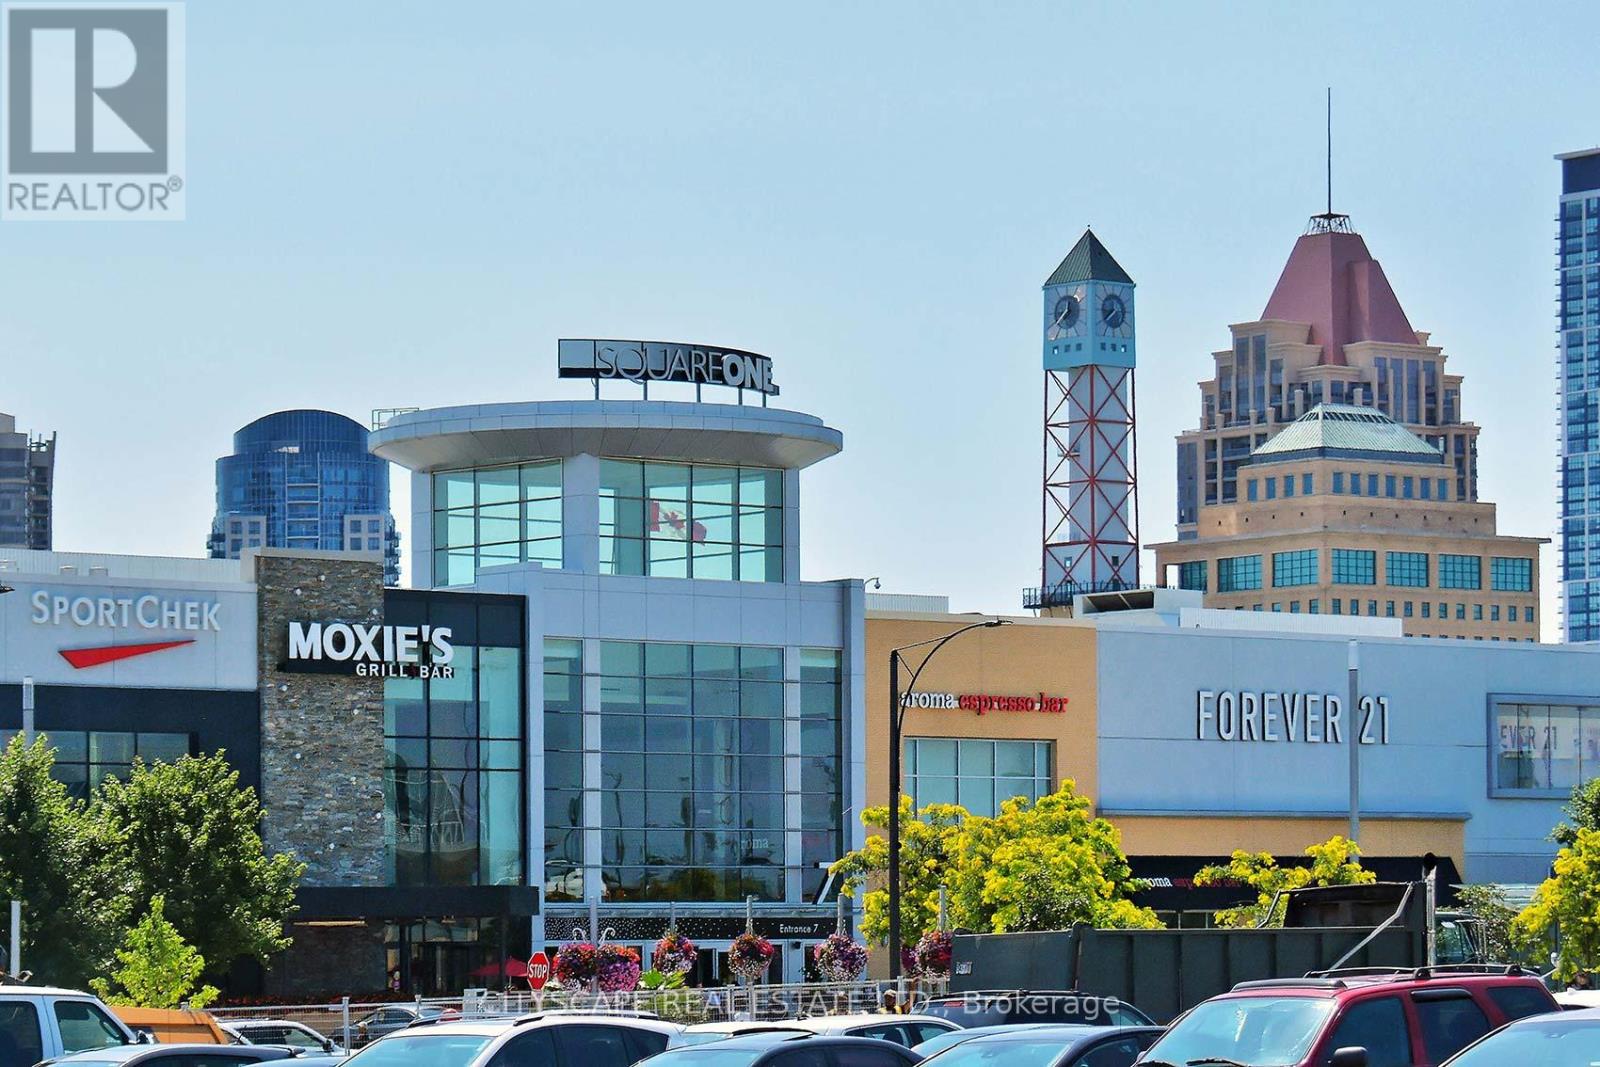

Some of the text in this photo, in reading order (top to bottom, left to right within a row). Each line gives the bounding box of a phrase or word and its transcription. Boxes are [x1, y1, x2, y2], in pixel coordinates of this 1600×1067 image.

[288, 621, 454, 664] MOXIE'S
[356, 662, 453, 679] GRILL BAR
[900, 691, 1069, 716] aroma espresso bar
[1196, 689, 1390, 745] FOREVER 21
[779, 923, 820, 934] Entrance 7
[528, 963, 548, 979] STOP
